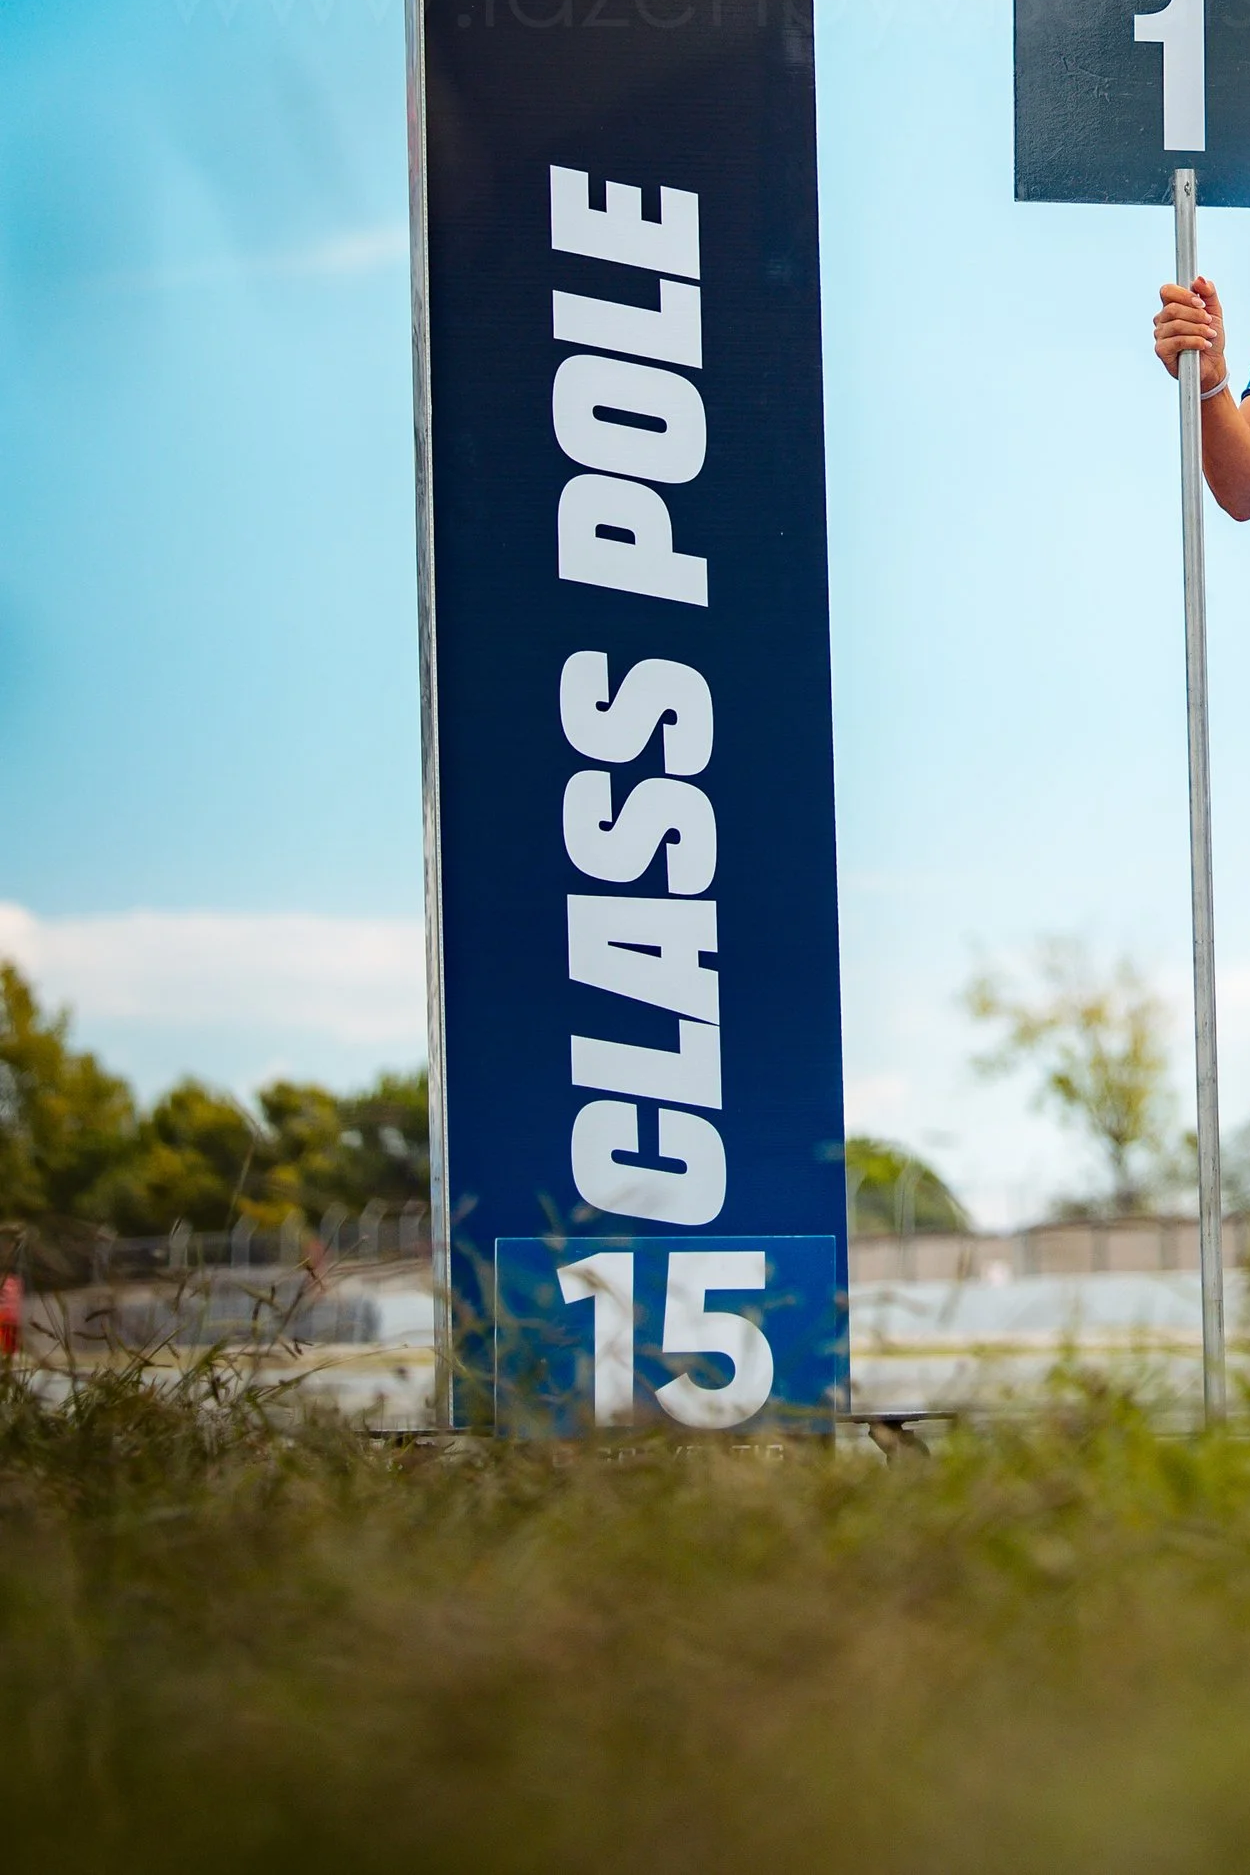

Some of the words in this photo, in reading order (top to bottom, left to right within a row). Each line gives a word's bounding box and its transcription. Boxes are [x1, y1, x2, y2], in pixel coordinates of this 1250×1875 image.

[549, 164, 709, 608] POLE
[558, 650, 727, 1226] CLASS
[556, 1250, 774, 1428] 15
